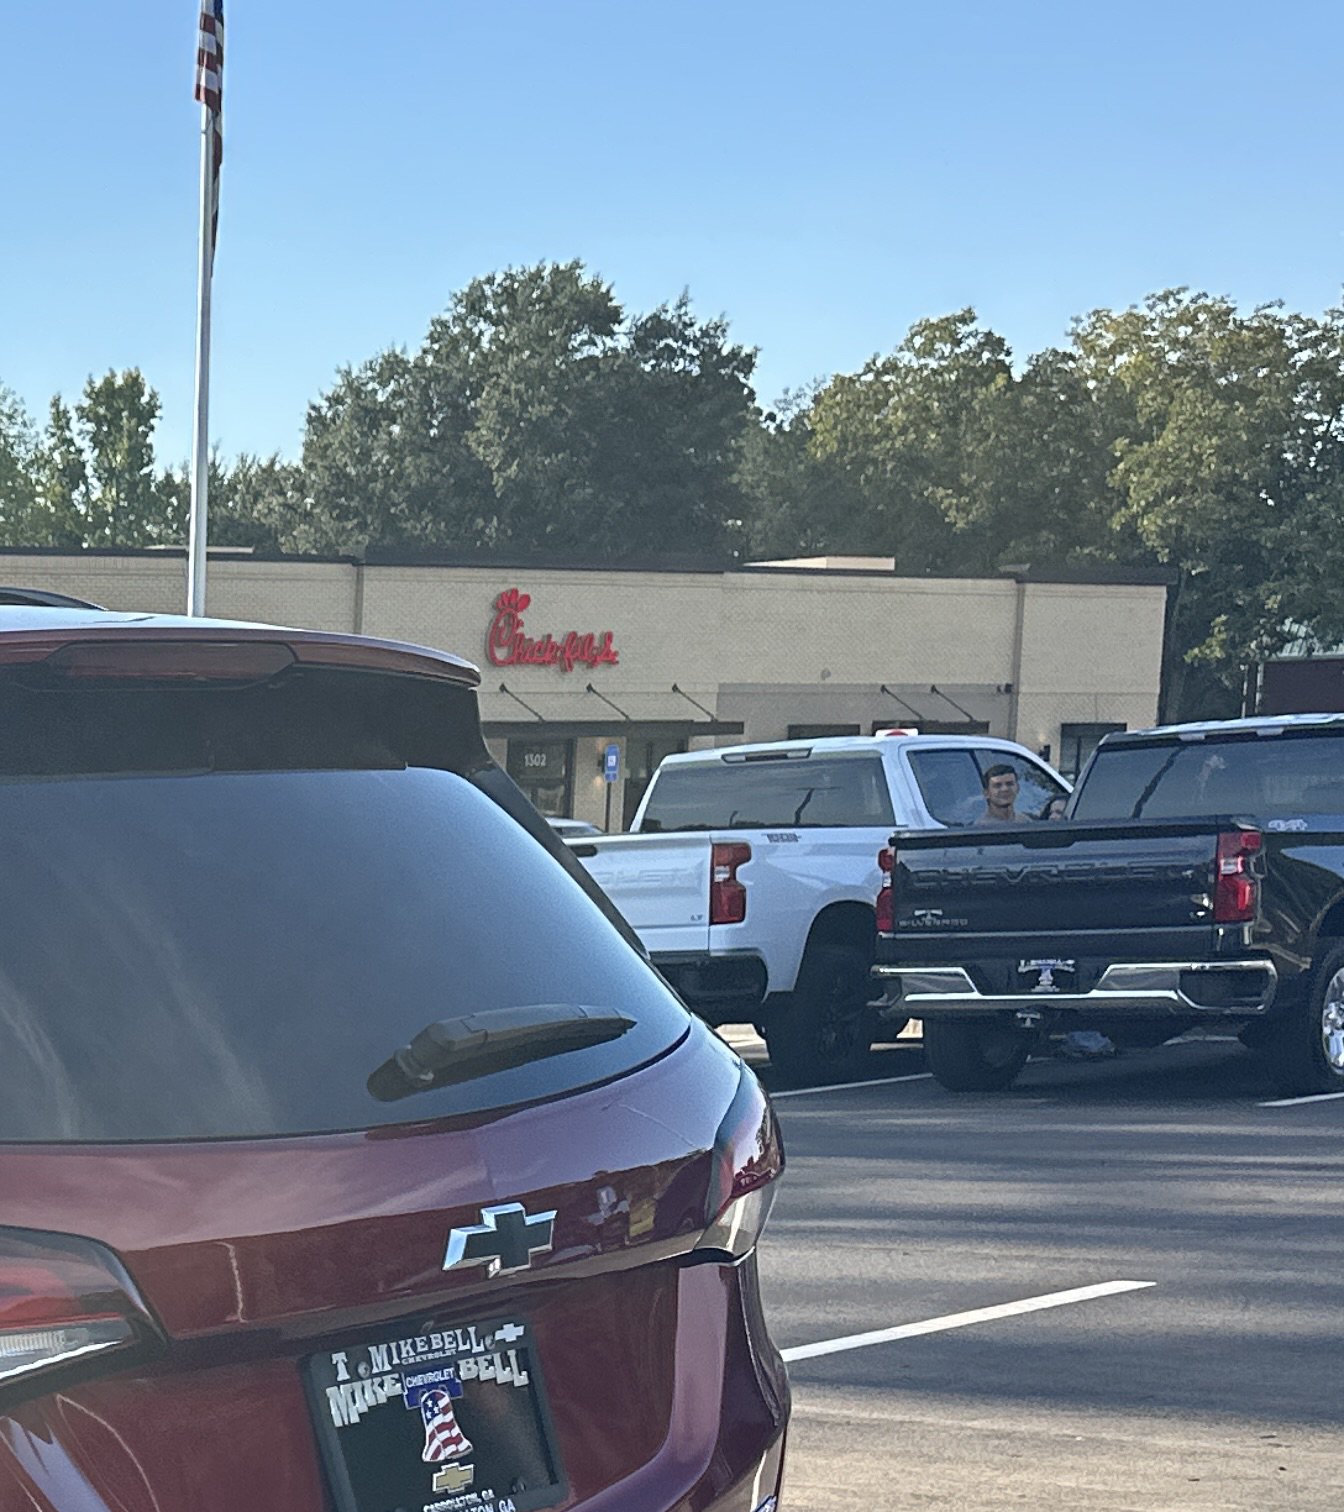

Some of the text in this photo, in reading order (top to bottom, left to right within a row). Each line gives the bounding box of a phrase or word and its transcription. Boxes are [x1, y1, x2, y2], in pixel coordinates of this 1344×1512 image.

[325, 1349, 529, 1428] MIKE CHEVROLET BELL
